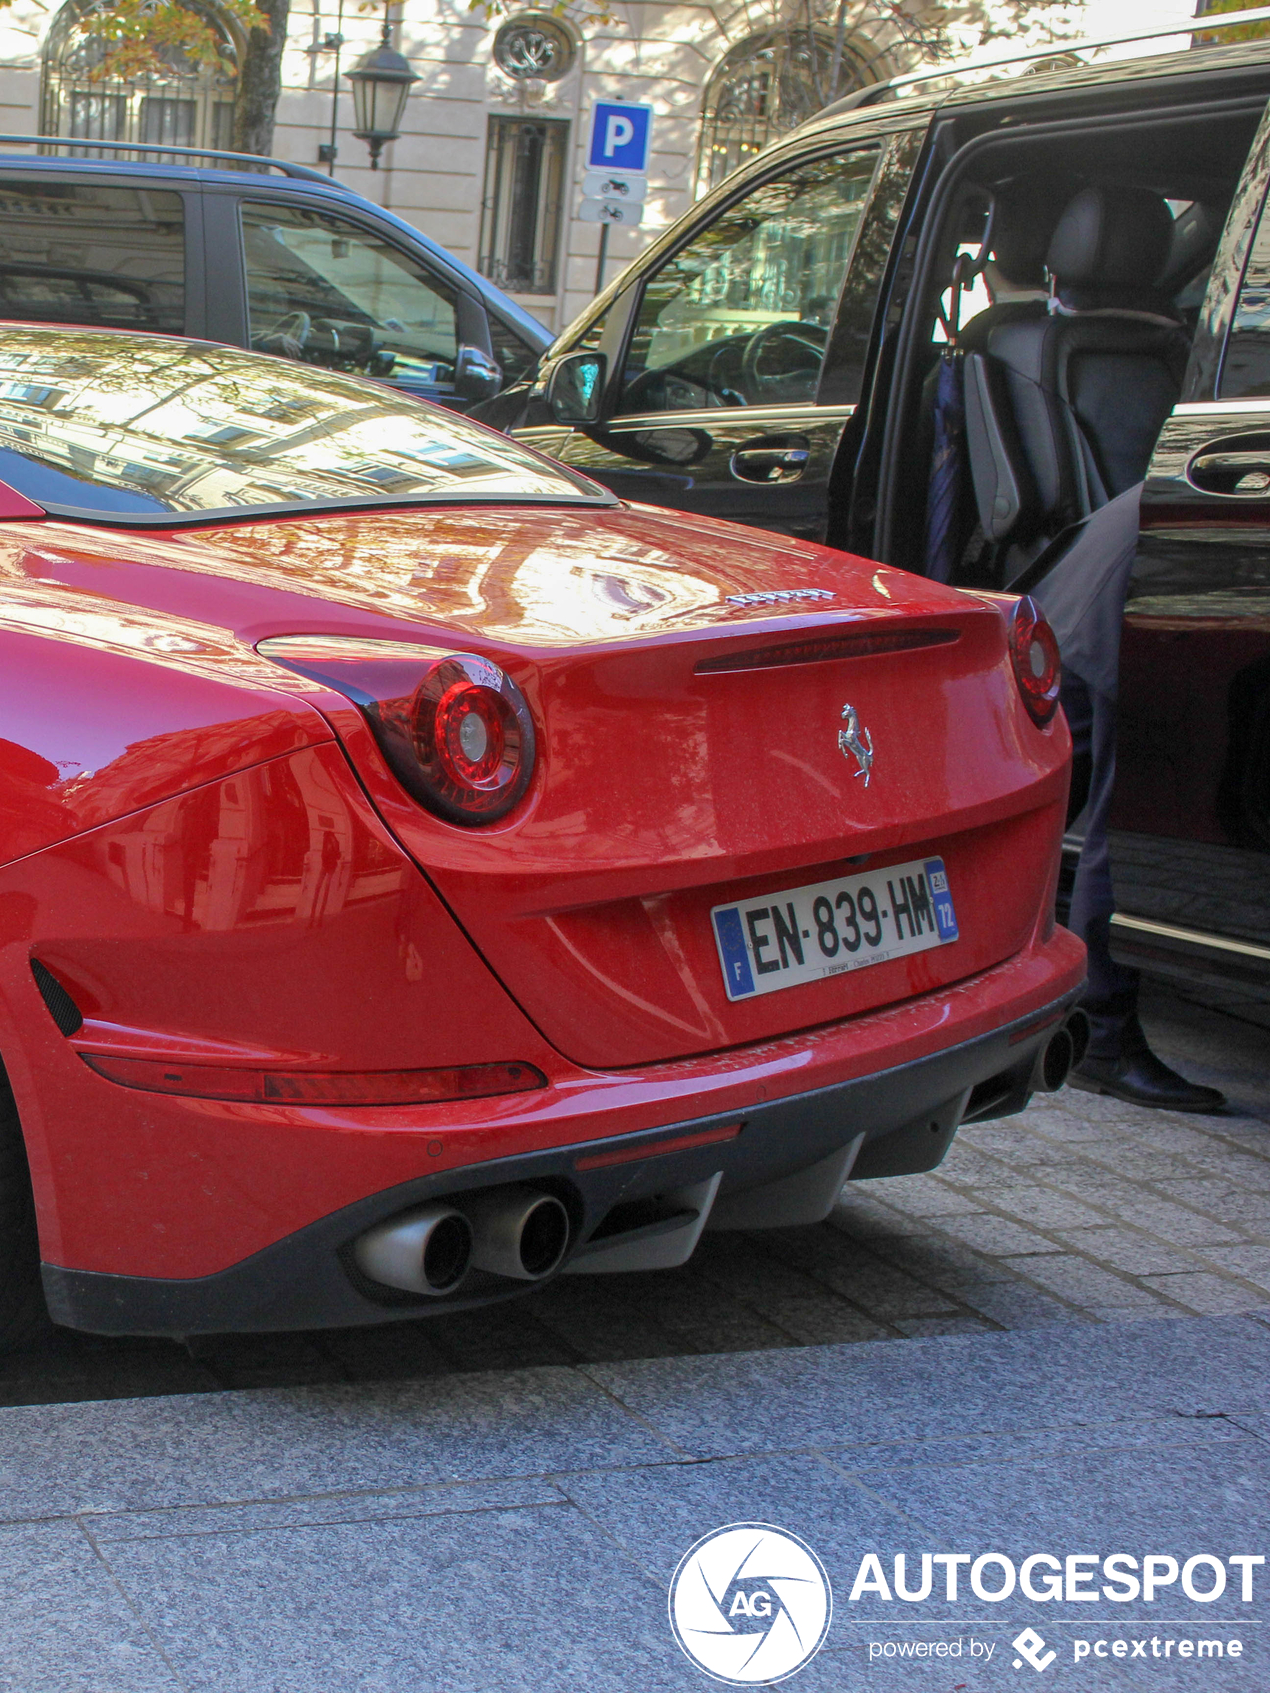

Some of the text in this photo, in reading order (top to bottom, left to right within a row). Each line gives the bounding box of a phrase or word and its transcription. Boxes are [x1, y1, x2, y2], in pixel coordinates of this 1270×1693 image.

[603, 114, 634, 158] P
[938, 902, 954, 928] 72
[733, 962, 742, 981] F
